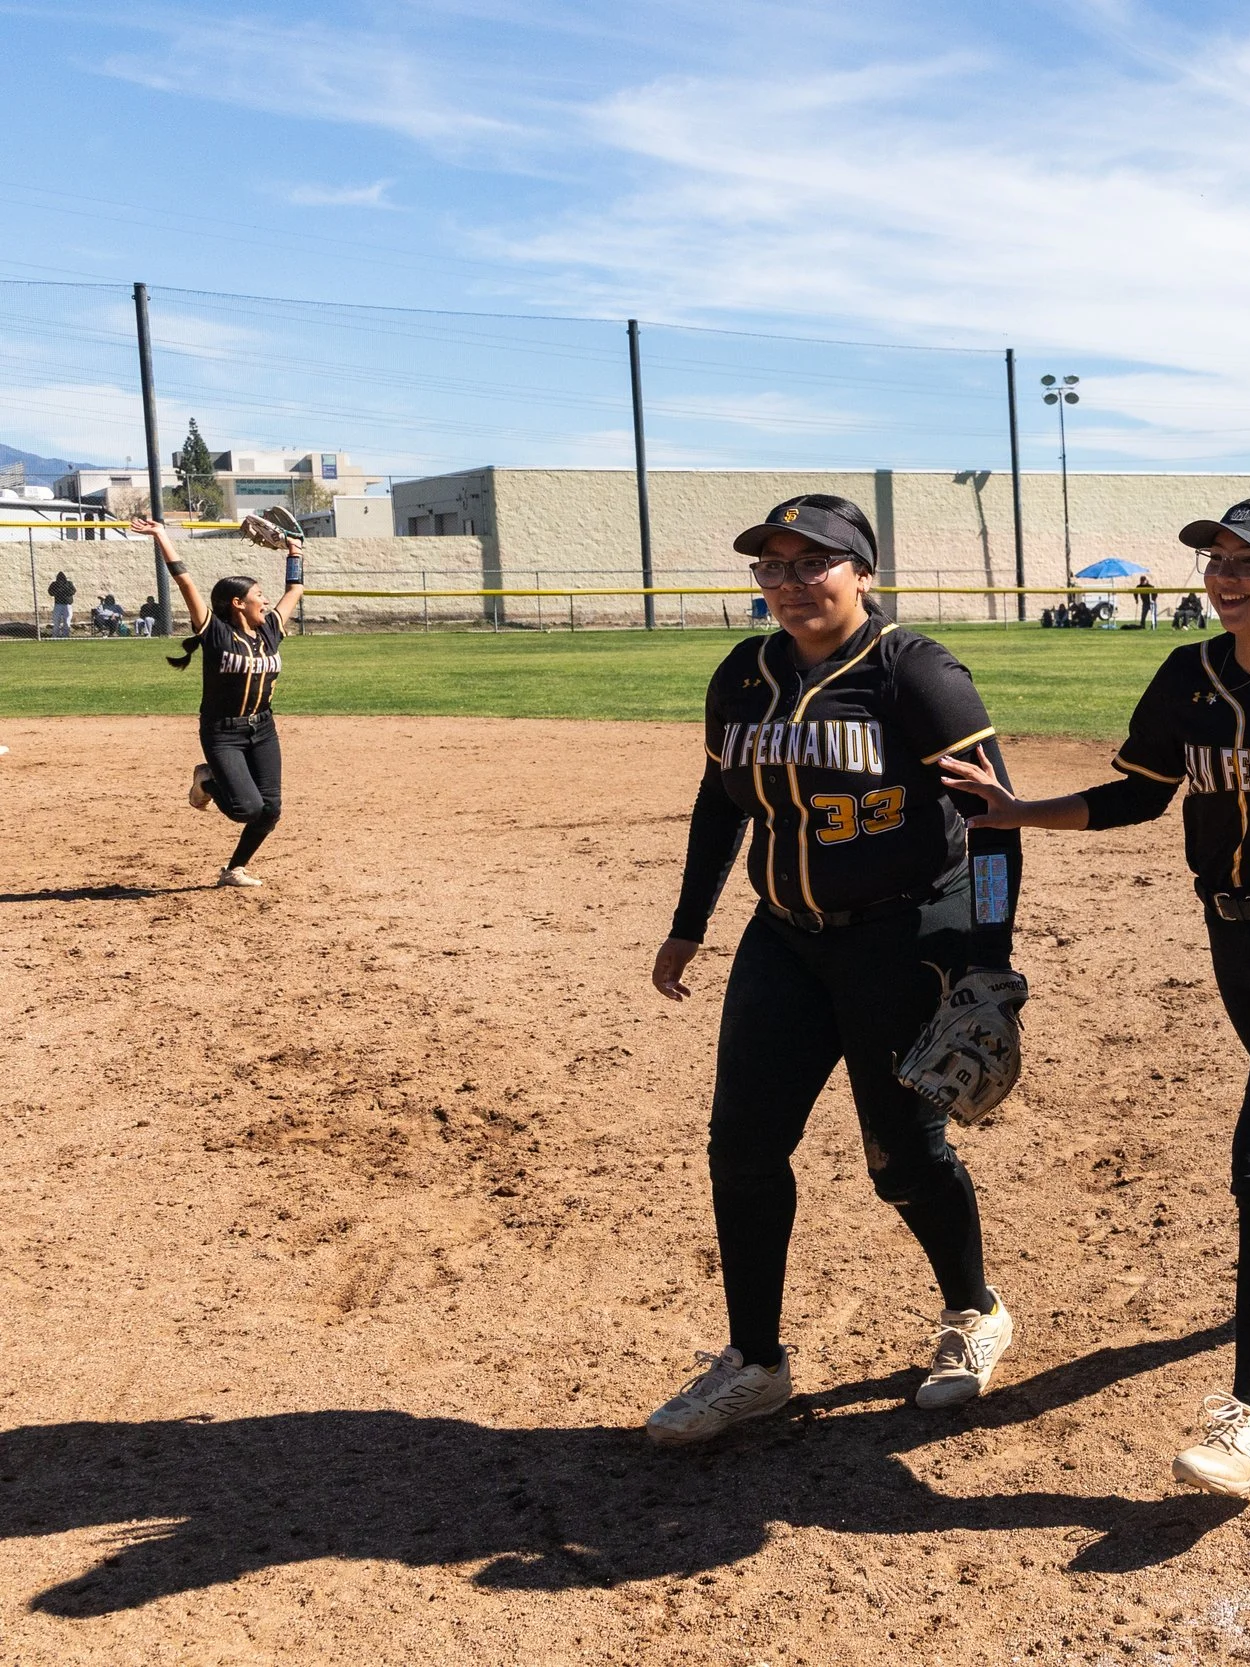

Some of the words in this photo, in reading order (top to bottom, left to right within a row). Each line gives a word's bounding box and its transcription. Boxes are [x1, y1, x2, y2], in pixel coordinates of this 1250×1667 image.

[220, 650, 243, 673] SAN
[738, 720, 885, 776] FERNANDO
[810, 785, 906, 846] 33
